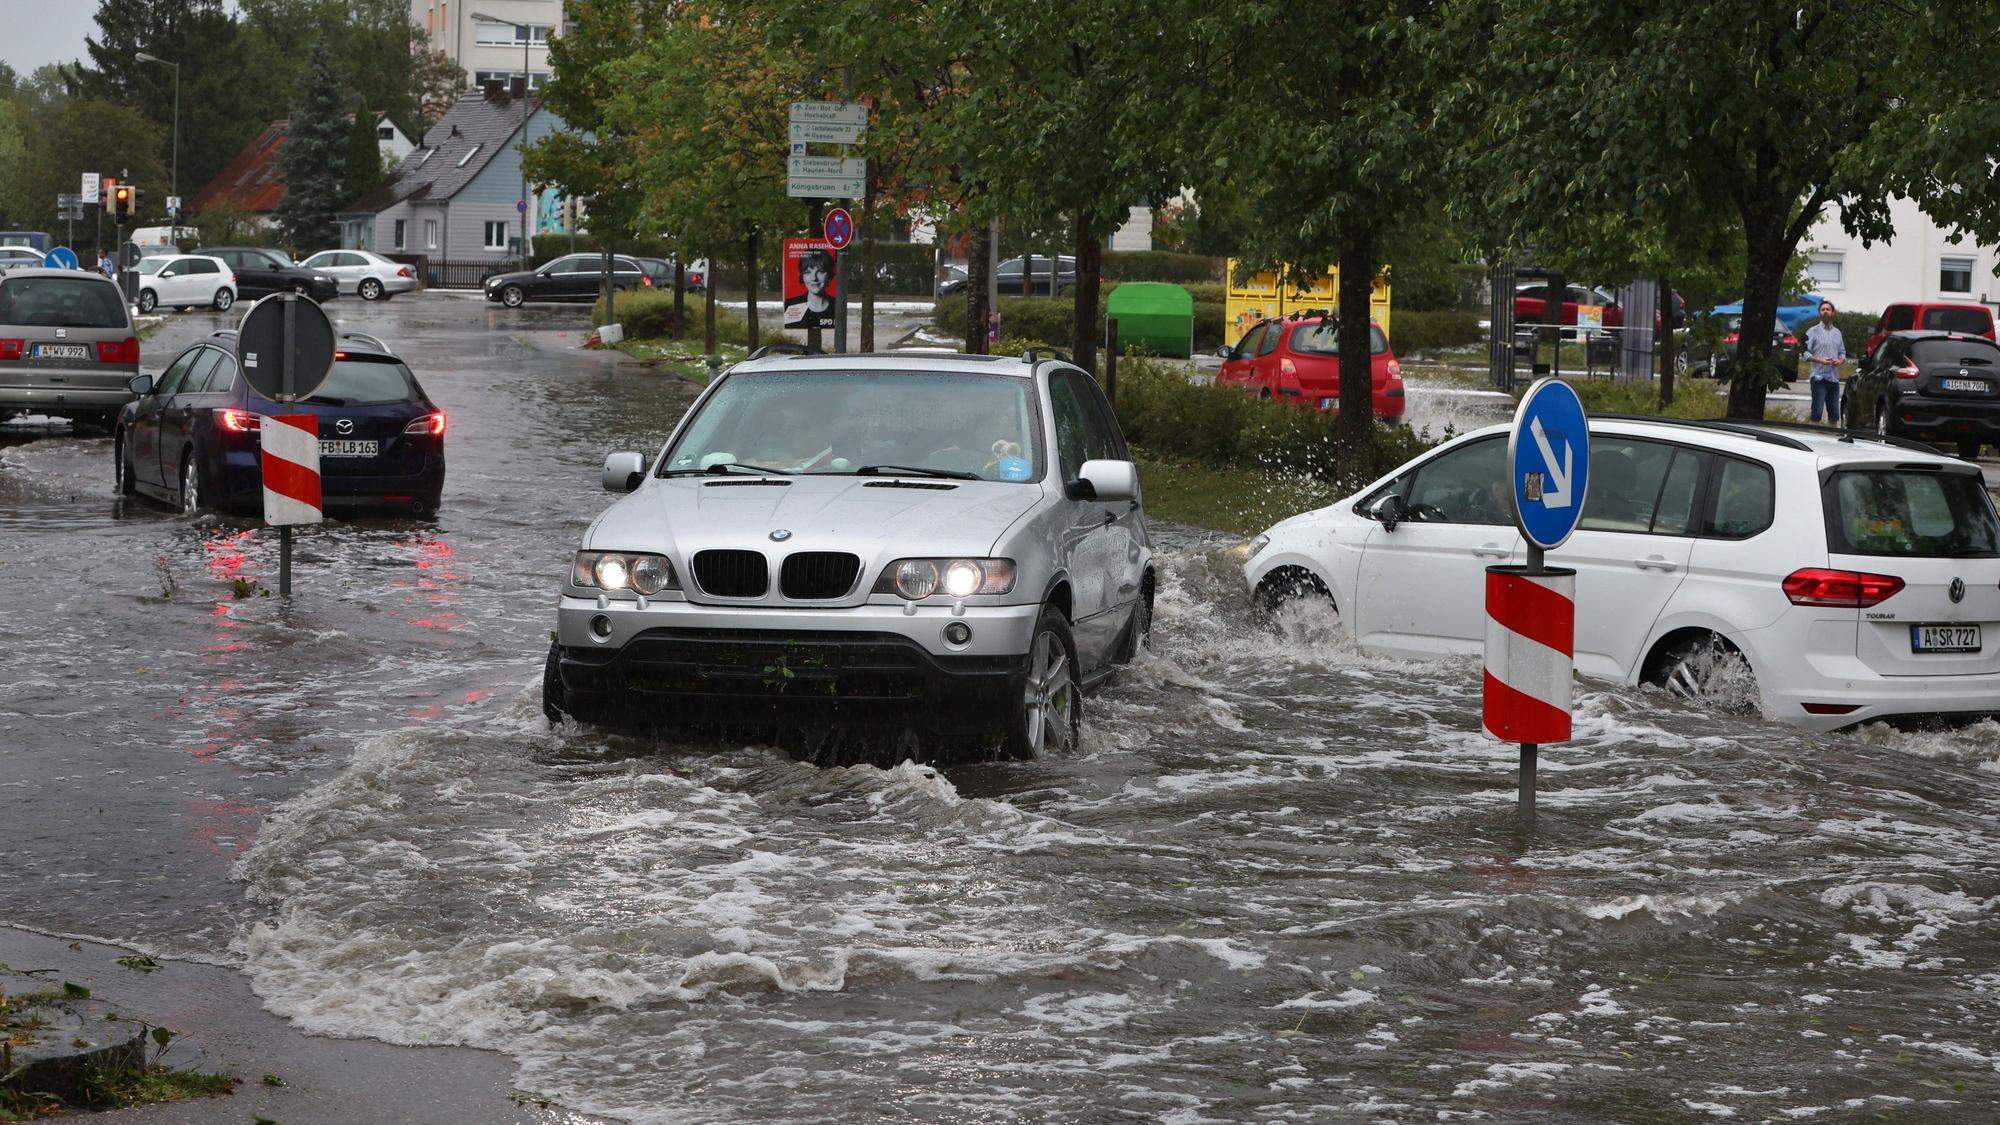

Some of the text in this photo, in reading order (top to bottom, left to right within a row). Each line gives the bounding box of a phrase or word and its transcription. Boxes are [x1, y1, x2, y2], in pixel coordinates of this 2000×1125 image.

[42, 346, 48, 355] A
[68, 348, 84, 356] 992
[318, 442, 378, 454] FB LB 163
[1924, 629, 1976, 646] A SR 727
